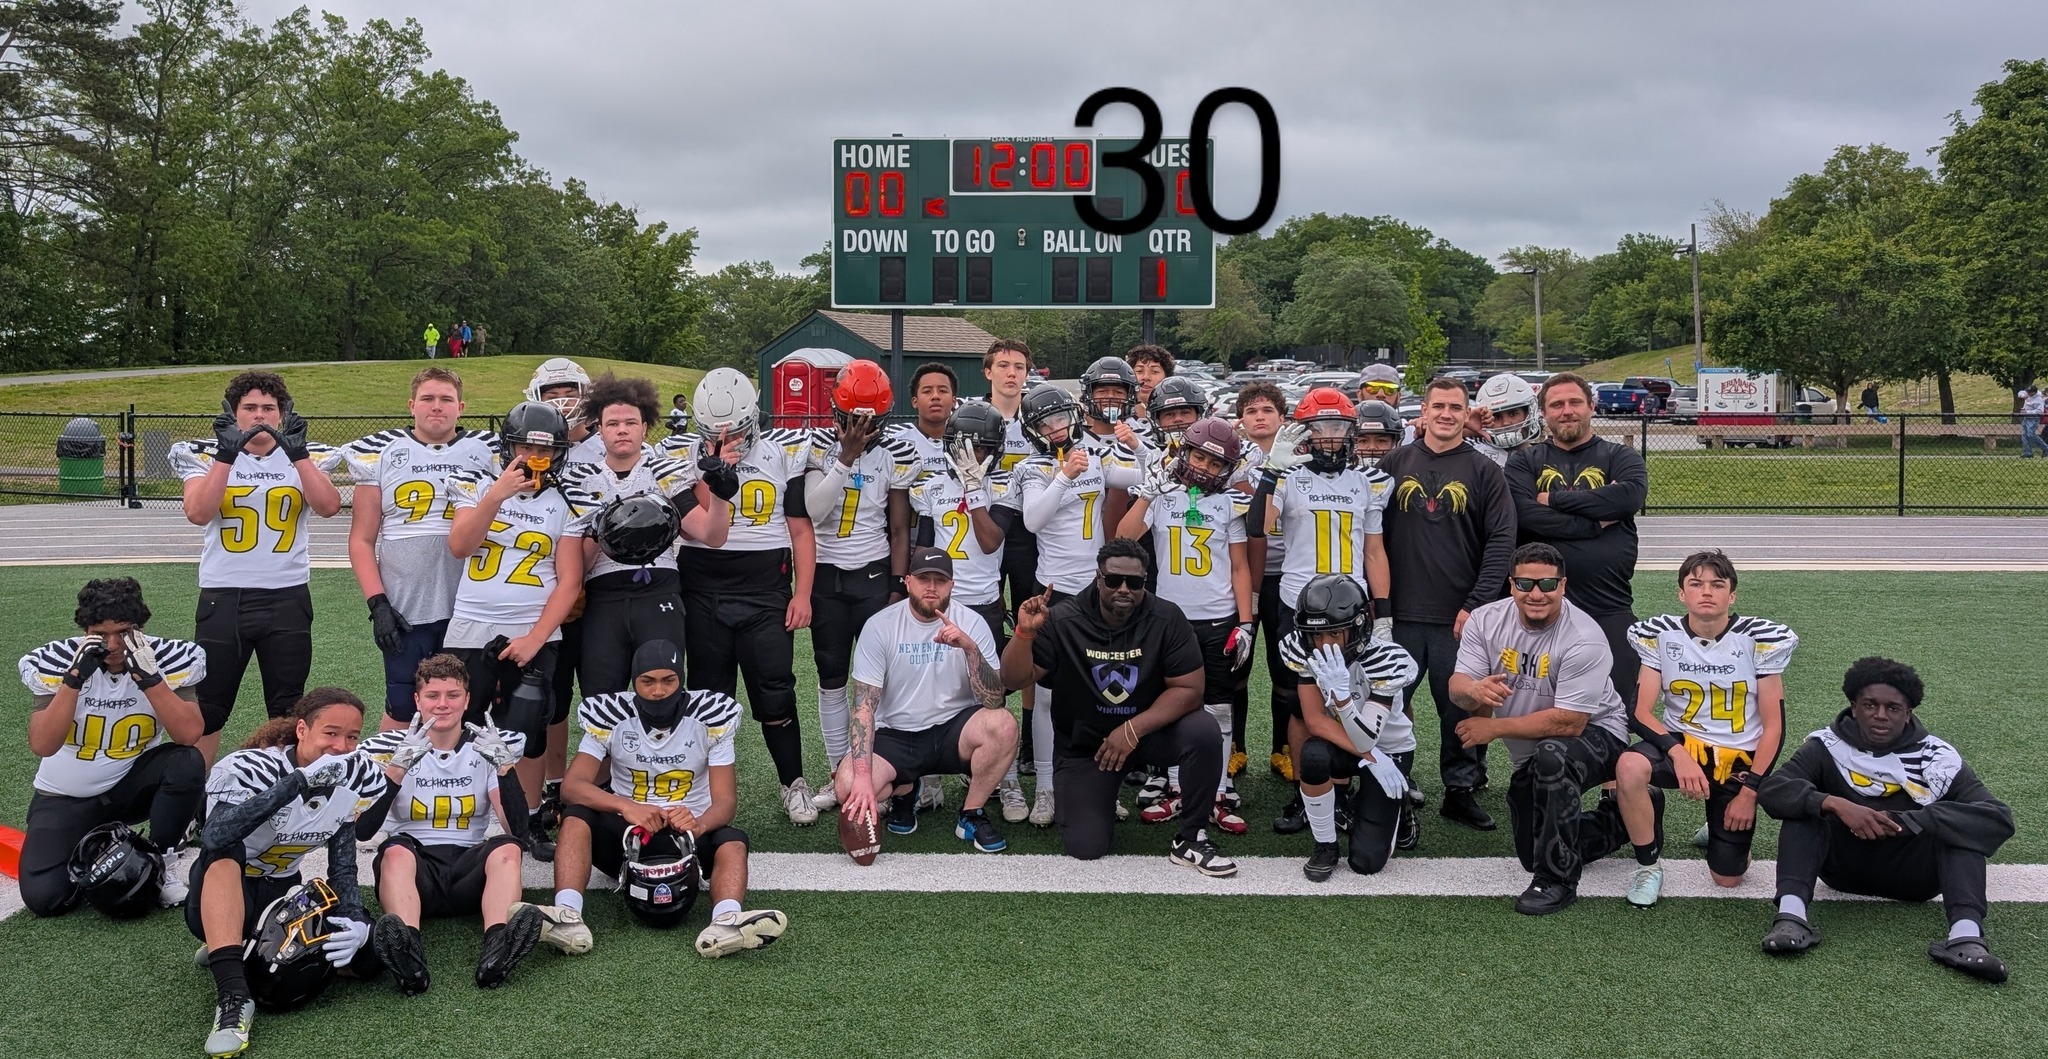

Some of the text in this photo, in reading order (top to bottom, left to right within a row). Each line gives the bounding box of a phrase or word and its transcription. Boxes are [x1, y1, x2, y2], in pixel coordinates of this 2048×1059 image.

[841, 145, 911, 168] HOME
[973, 143, 1090, 188] 12:00
[1142, 143, 1190, 168] UES
[845, 172, 904, 216] 00
[843, 230, 907, 253] DOWN
[932, 229, 995, 253] TO GO
[1043, 229, 1122, 253] BALL ON
[1149, 229, 1191, 253] QTR
[1157, 258, 1167, 298] 1
[1308, 493, 1354, 505] ROCKHOPPERS
[220, 485, 304, 553] 59
[836, 486, 861, 538] 1
[1077, 491, 1101, 540] 7
[942, 510, 969, 560] 2
[1308, 509, 1354, 575] 11
[468, 520, 554, 587] 52
[1167, 525, 1214, 577] 13
[898, 643, 921, 654] NEW
[1521, 652, 1539, 678] RH
[1678, 662, 1736, 675] ROCKHOPPERS
[84, 697, 138, 710] ROCKHOPPERS
[1096, 705, 1138, 715] VIKINGS
[1669, 679, 1748, 733] 24
[415, 775, 473, 790] ROCKHOPPERS
[273, 830, 334, 843] ROCKHOPPERS
